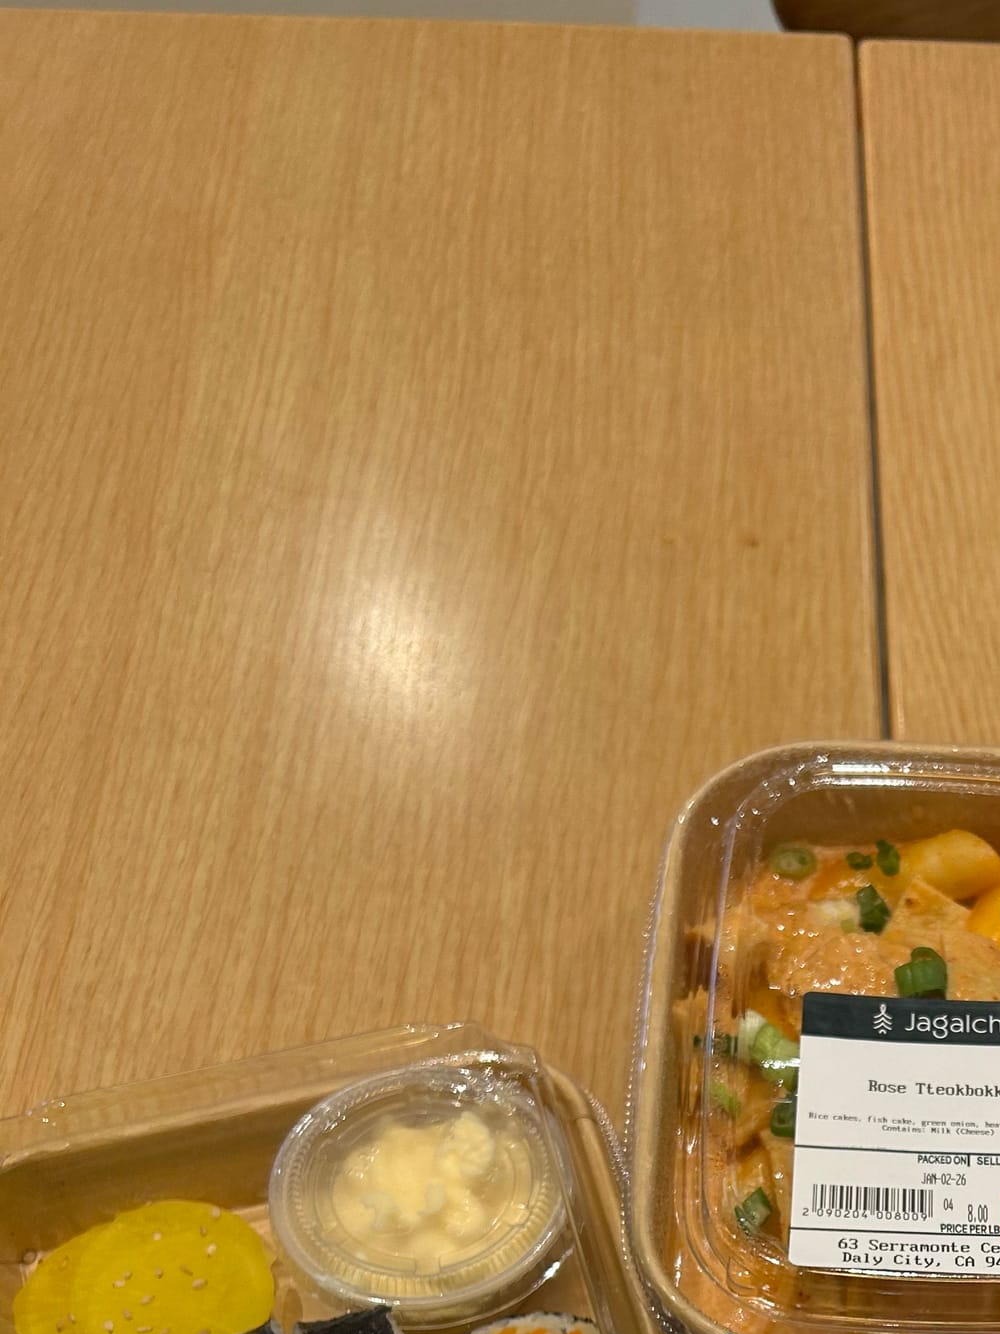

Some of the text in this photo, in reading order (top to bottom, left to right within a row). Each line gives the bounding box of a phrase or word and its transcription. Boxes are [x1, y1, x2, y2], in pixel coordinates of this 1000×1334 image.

[868, 1079, 906, 1093] Rose
[808, 1111, 829, 1120] Rice
[867, 1115, 888, 1123] fish
[920, 1120, 947, 1129] green
[881, 1124, 926, 1133] Contains:
[955, 1127, 995, 1136] (Cheese)
[917, 1154, 951, 1164] PACKED
[953, 1155, 966, 1164] ON
[976, 1156, 1000, 1165] SELL
[921, 1172, 966, 1186] JAN-02-26
[943, 1198, 953, 1210] 04
[802, 1207, 929, 1221] 2 090204 008009
[967, 1203, 988, 1223] 8.00
[940, 1223, 967, 1233] PRICE
[969, 1224, 987, 1234] PER
[837, 1238, 858, 1249] 63
[868, 1239, 970, 1252] Serramonte
[842, 1251, 882, 1265] Daly
[893, 1254, 940, 1268] City,
[954, 1255, 974, 1267] CA
